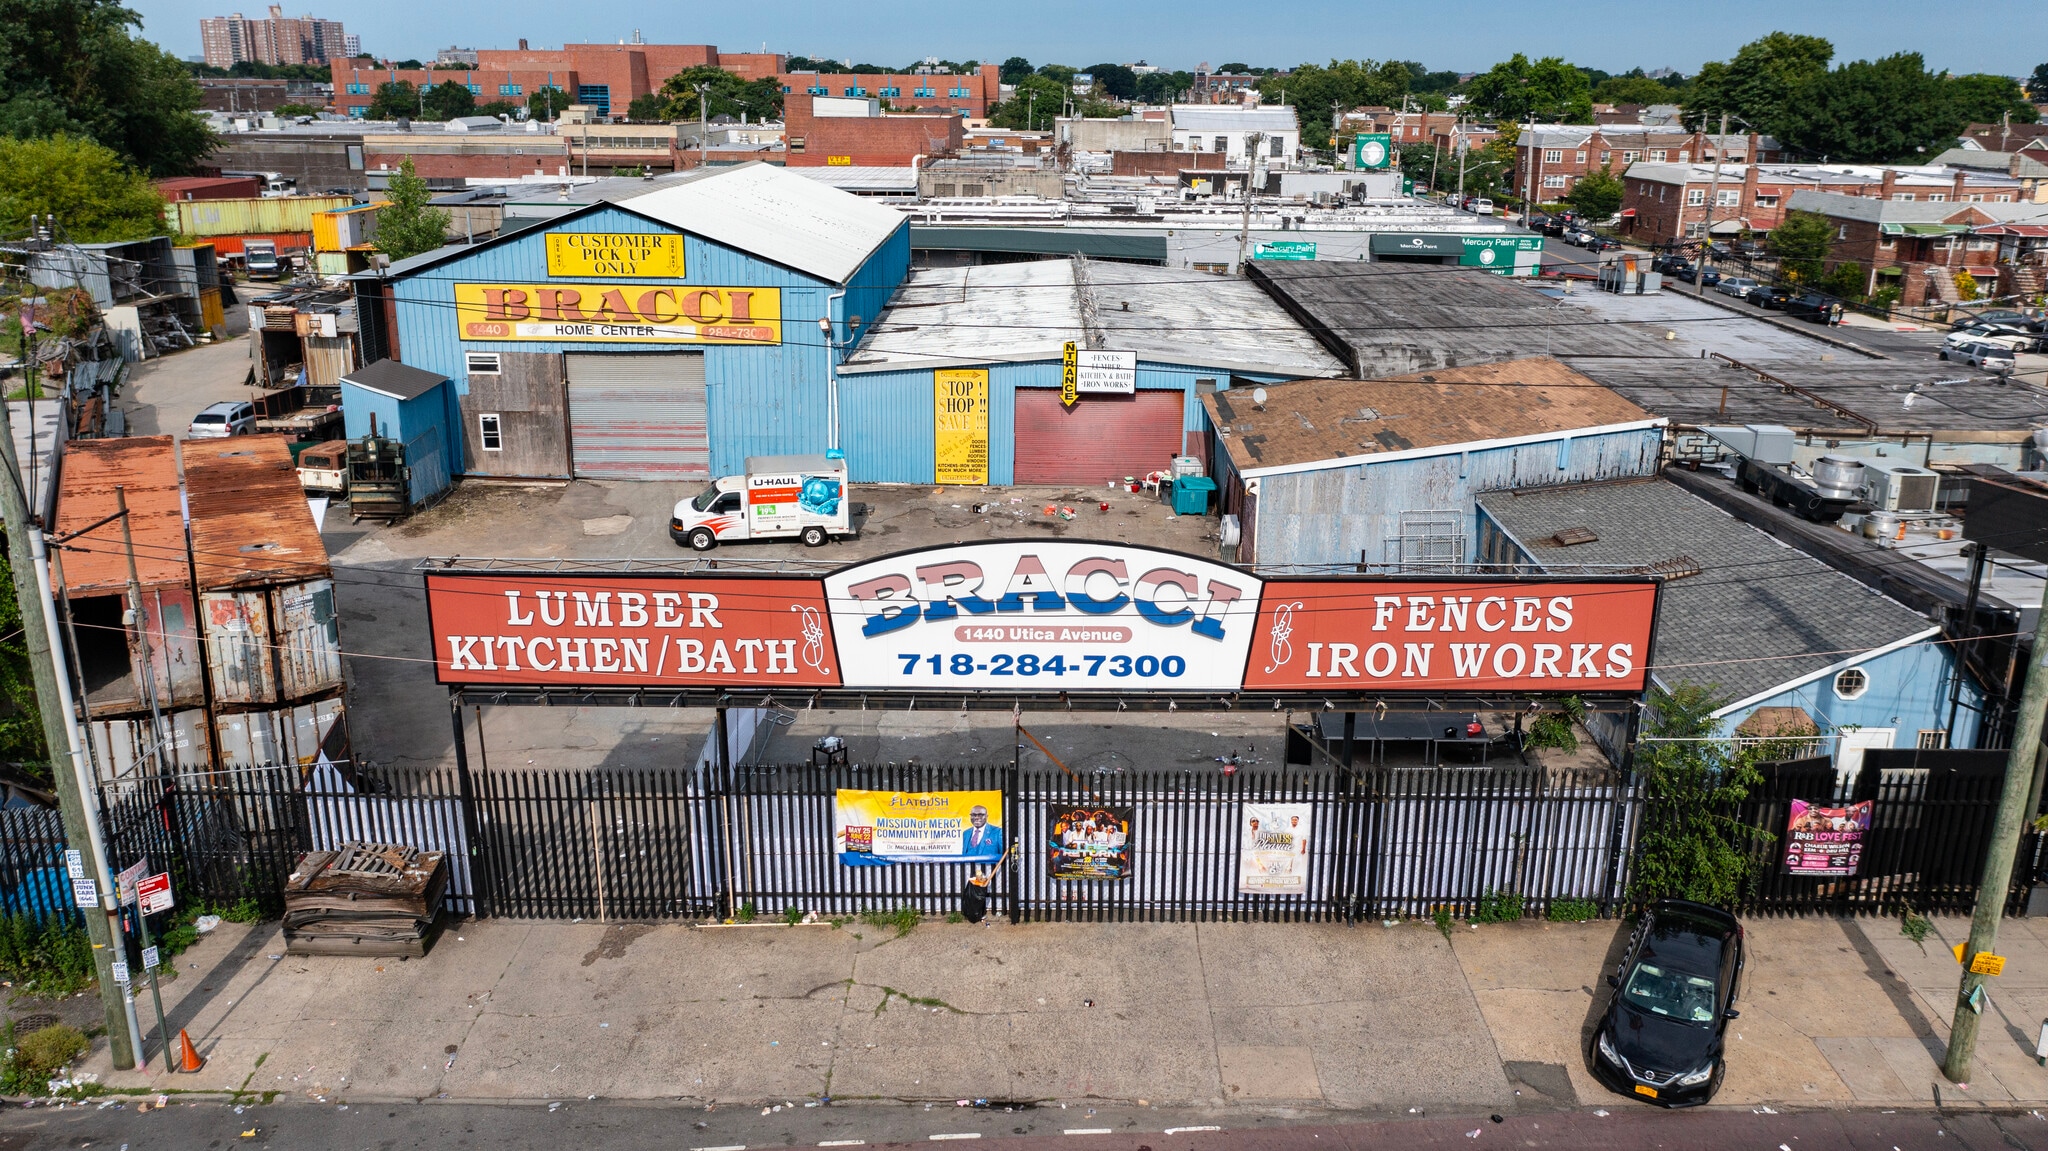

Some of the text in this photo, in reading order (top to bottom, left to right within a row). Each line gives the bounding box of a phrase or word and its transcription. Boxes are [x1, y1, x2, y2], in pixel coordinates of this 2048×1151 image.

[568, 235, 662, 248] CUSTOMER
[1462, 238, 1493, 247] Mercury
[1296, 244, 1314, 252] Paint
[583, 249, 650, 260] PICK UP
[594, 262, 638, 274] ONLY
[482, 288, 754, 324] BRACCI
[555, 325, 593, 335] HOME
[601, 326, 655, 336] CENTER
[1064, 341, 1074, 400] NTRANCE
[754, 478, 797, 486] U-HAUL
[848, 554, 1242, 642] BRACCI
[504, 590, 723, 628] LUMBER
[1371, 596, 1574, 632] FENCES
[964, 627, 1122, 642] 1440 Utica Avenue
[447, 634, 798, 676] KITCHEN/BATH
[1306, 642, 1634, 679] IRON WORKS
[898, 653, 1186, 677] 718-284-7300
[889, 796, 948, 807] FLATBUSH
[877, 818, 961, 828] MISSION OF MERCY
[877, 829, 961, 838] COMMUNITY IMPACT
[1794, 832, 1862, 841] R&B LOVE FEST
